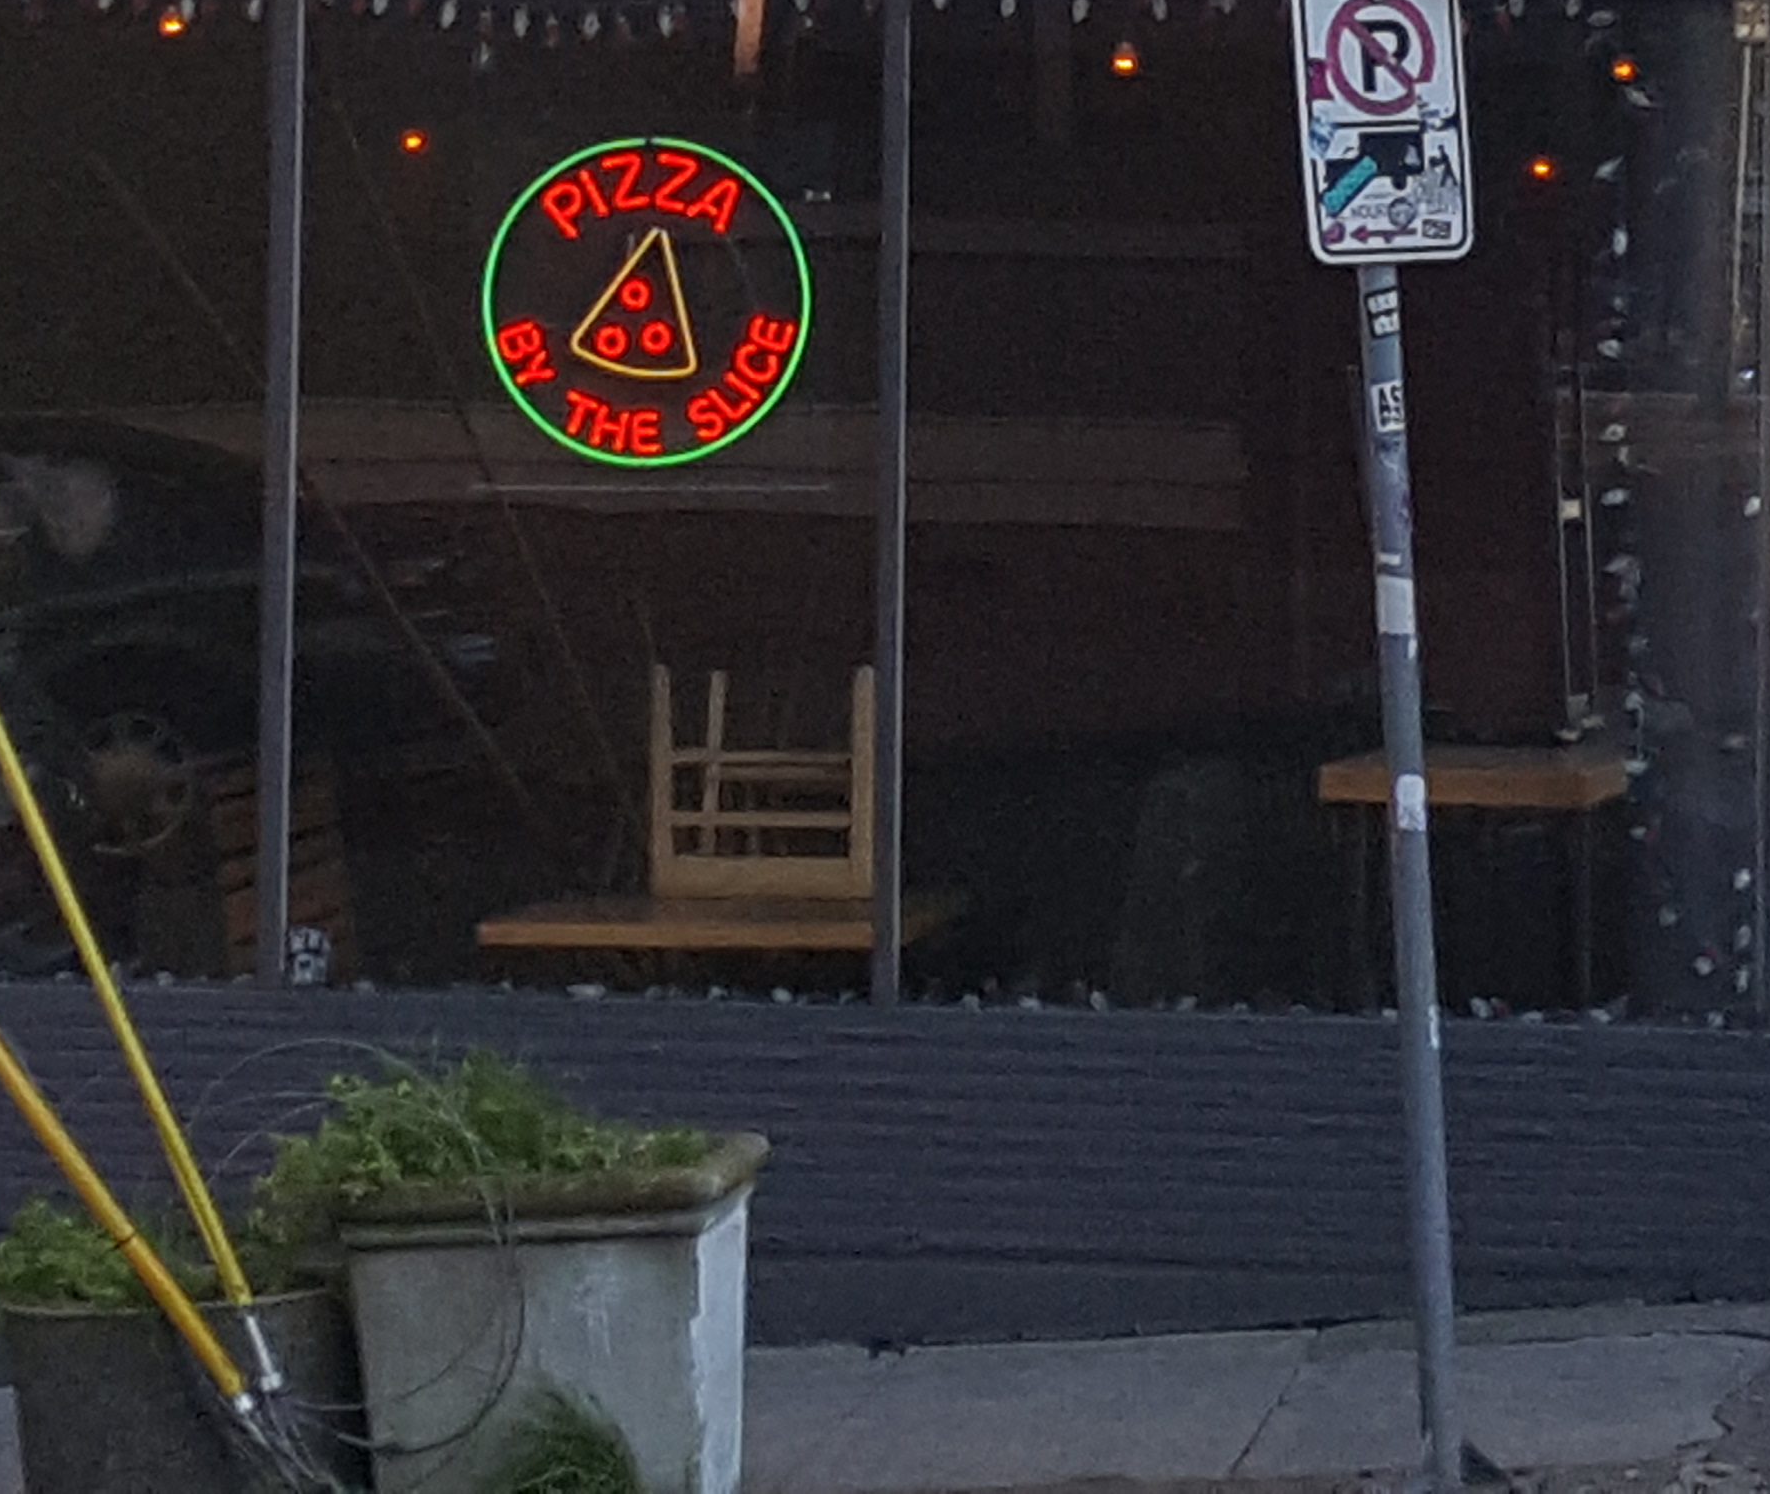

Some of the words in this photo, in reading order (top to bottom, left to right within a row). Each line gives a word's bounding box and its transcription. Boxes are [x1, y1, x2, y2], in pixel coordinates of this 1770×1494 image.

[543, 153, 740, 237] PIZZA
[497, 320, 557, 386] BY
[566, 389, 664, 455] THE
[687, 315, 796, 441] SLICE
